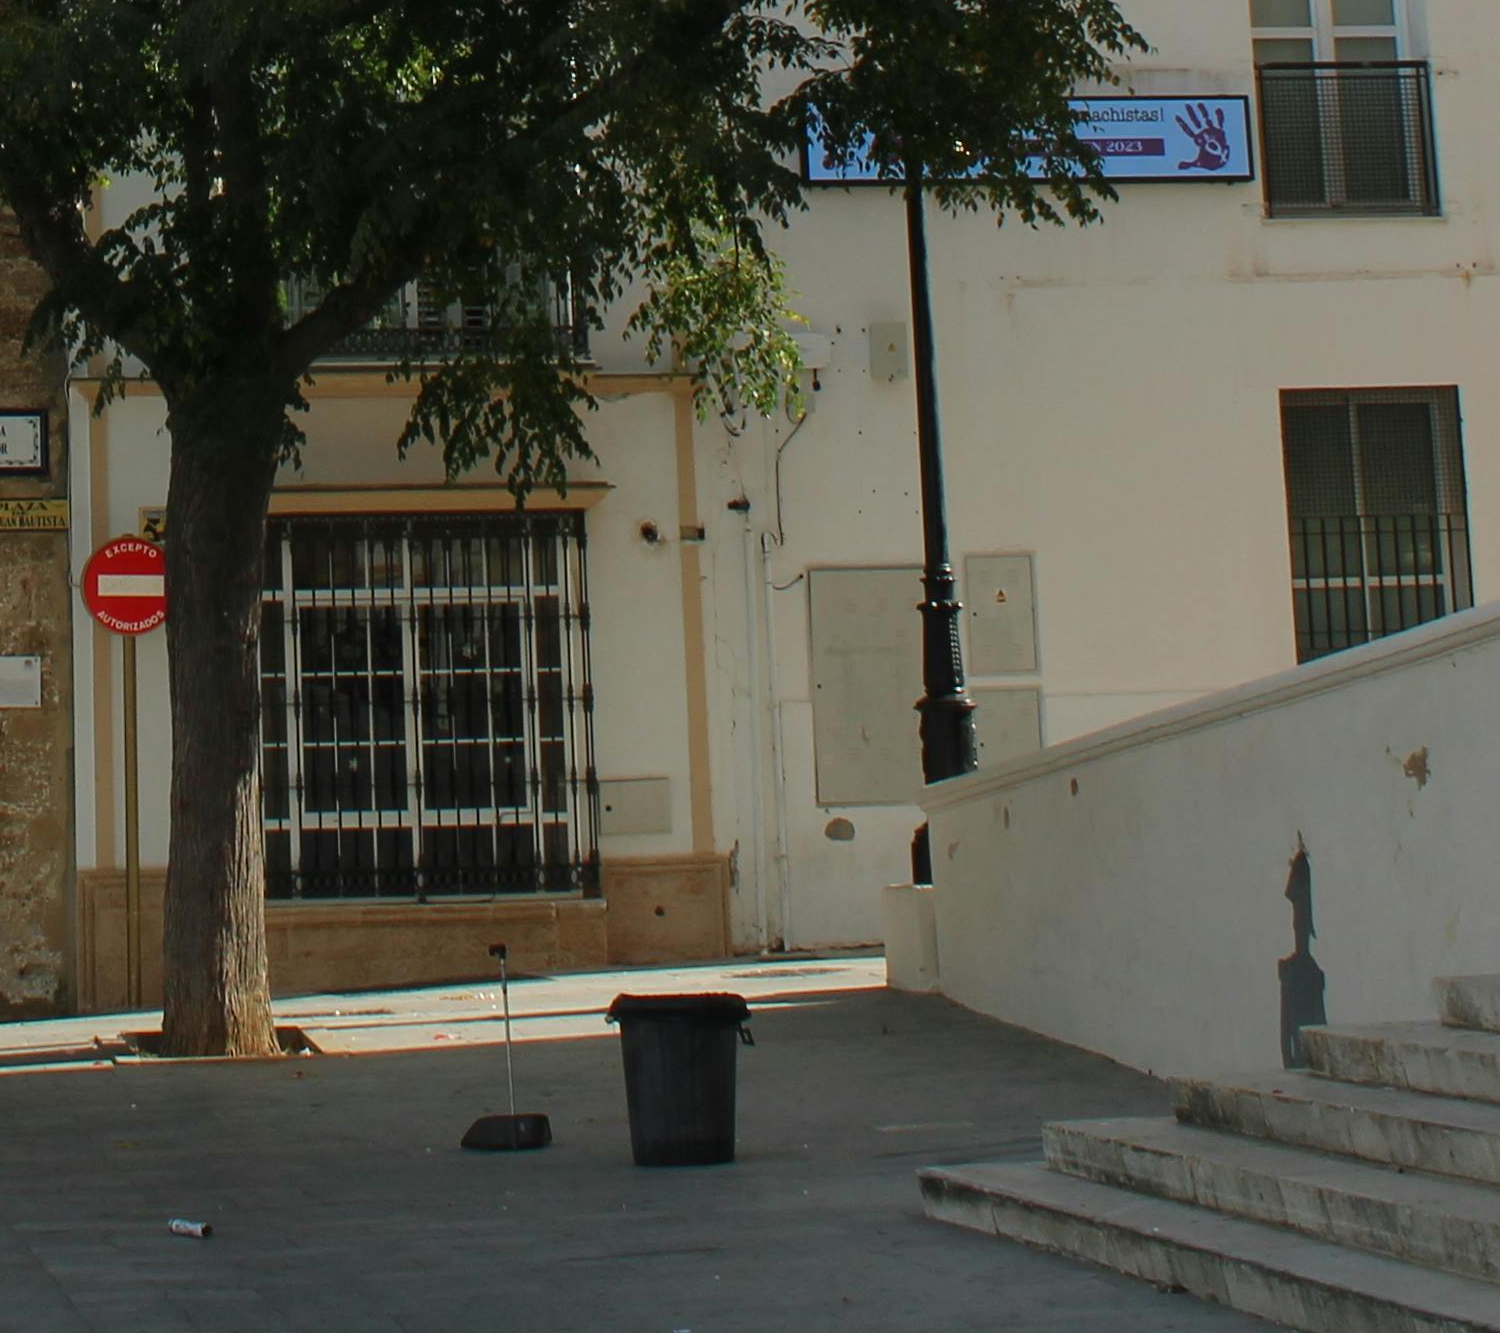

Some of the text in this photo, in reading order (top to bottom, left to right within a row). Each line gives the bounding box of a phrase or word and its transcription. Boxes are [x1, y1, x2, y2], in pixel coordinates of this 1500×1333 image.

[1079, 107, 1164, 123] achistas!
[1106, 140, 1143, 153] 2023
[19, 516, 66, 527] BAUTISTA
[105, 542, 157, 559] EXCEPTO
[97, 610, 165, 631] AUTORIZADOS
